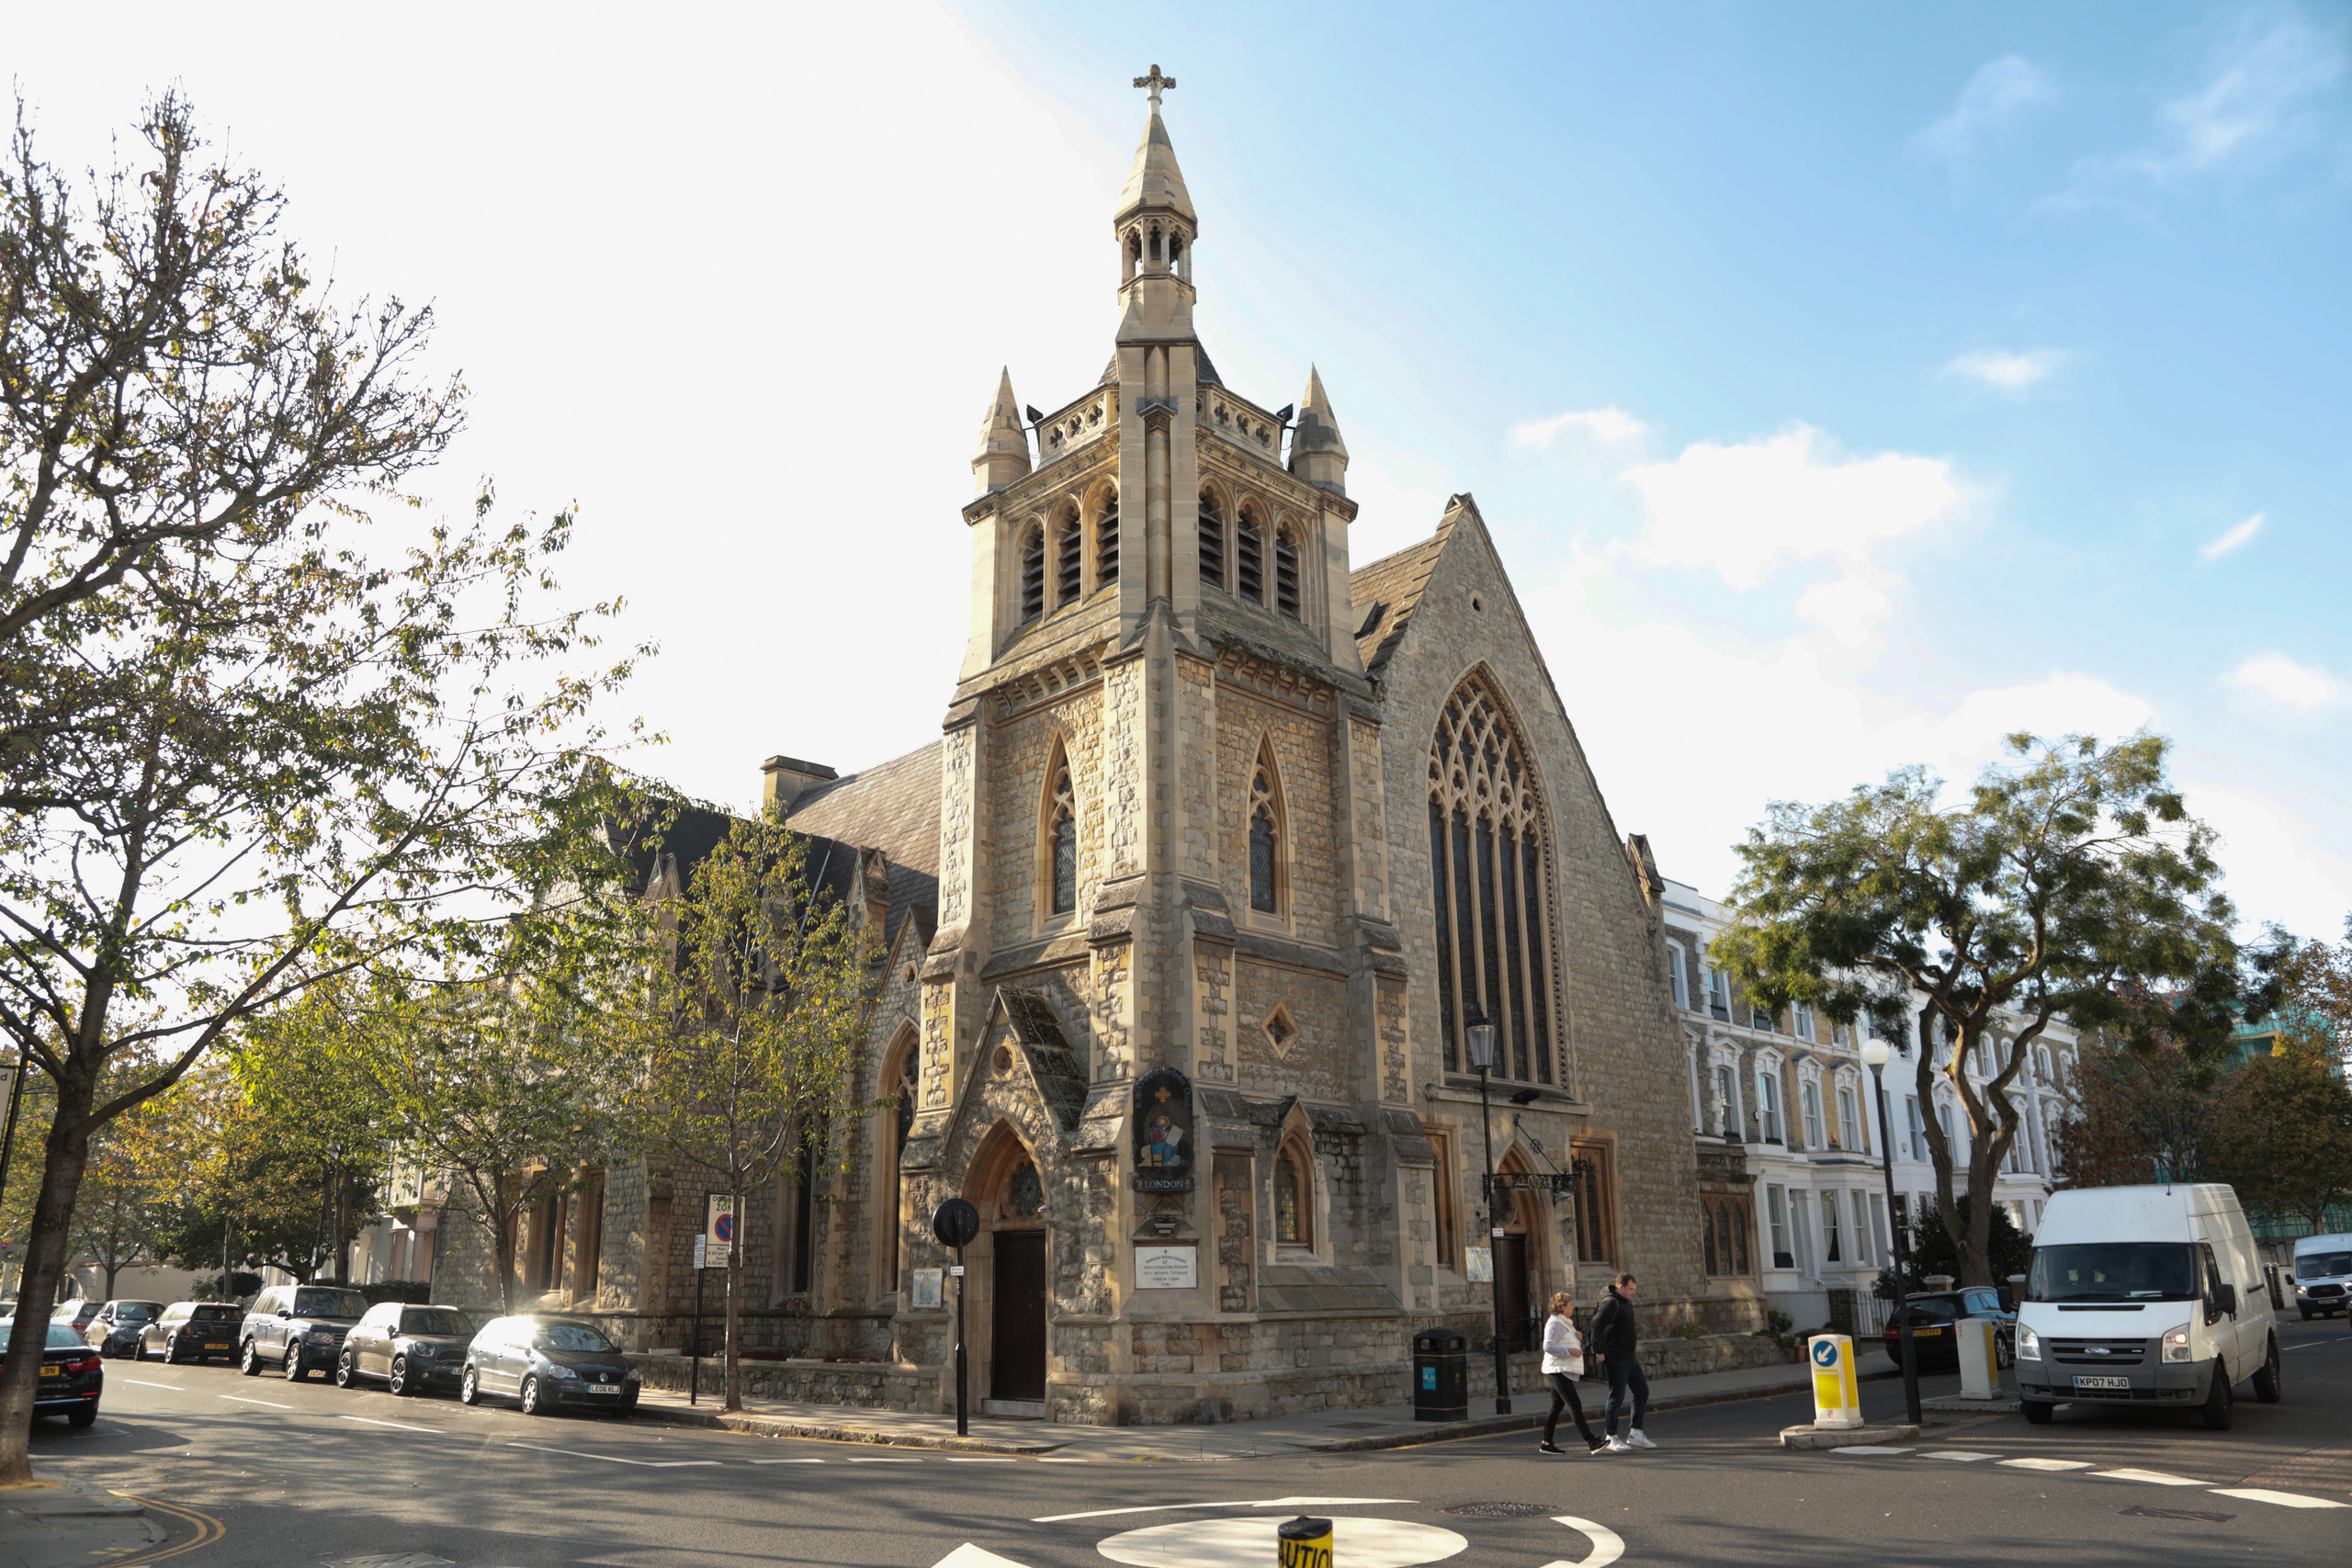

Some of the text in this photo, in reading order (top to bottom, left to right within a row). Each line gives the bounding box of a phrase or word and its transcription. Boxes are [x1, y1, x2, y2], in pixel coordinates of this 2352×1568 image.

[2080, 1378, 2127, 1387] KP07 HJO
[1278, 1539, 1332, 1568] AUTIO
